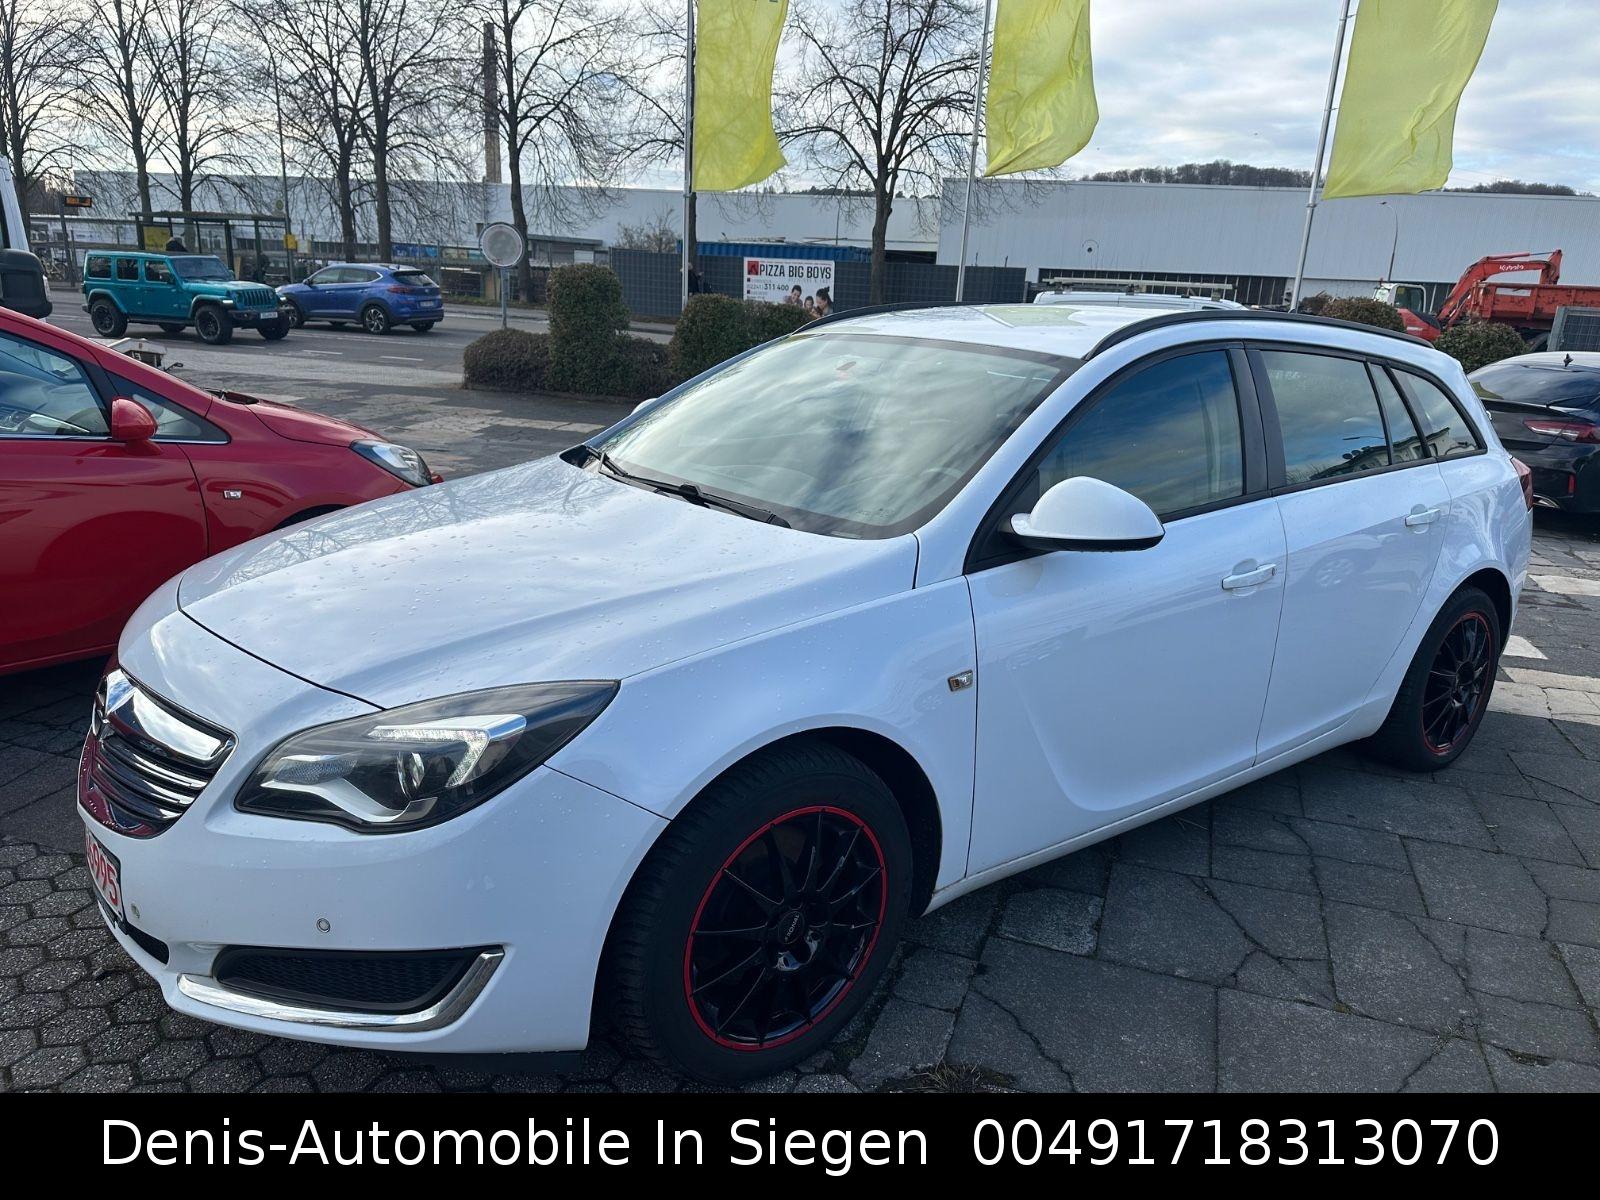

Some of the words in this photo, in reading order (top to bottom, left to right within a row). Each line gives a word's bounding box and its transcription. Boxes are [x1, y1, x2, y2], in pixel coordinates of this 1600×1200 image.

[760, 264, 785, 277] PIZZA
[788, 265, 804, 278] BIG
[807, 266, 832, 279] BOYS
[777, 284, 790, 292] 400
